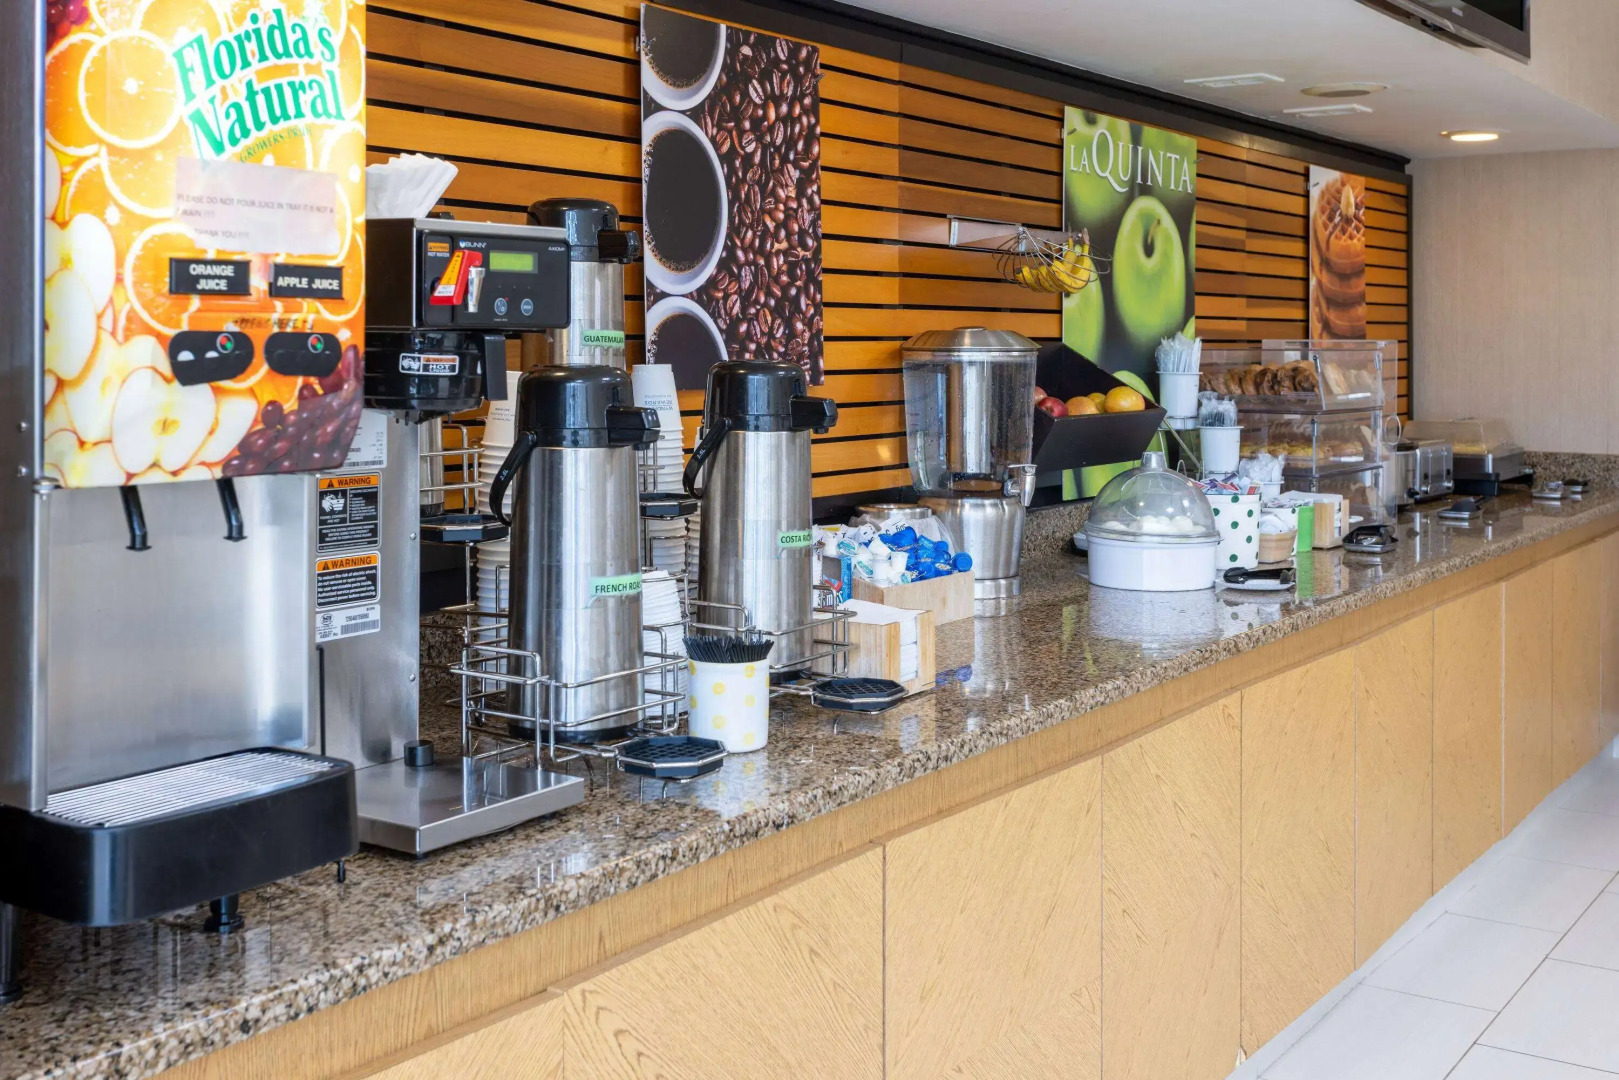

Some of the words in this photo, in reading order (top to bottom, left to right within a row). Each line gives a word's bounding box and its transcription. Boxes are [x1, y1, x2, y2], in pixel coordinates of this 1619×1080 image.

[187, 69, 346, 158] Natural
[1070, 144, 1090, 173] LA
[1091, 129, 1193, 193] QUINTA
[206, 196, 218, 206] DO
[220, 197, 234, 206] NOT
[189, 264, 235, 276] ORANGE
[196, 279, 228, 290] JUICE
[277, 276, 309, 288] APPLE
[312, 278, 340, 290] JUICE
[337, 476, 372, 487] WARNING
[780, 536, 802, 544] COSTA
[332, 556, 372, 568] WARNING
[595, 583, 627, 594] FRENCH
